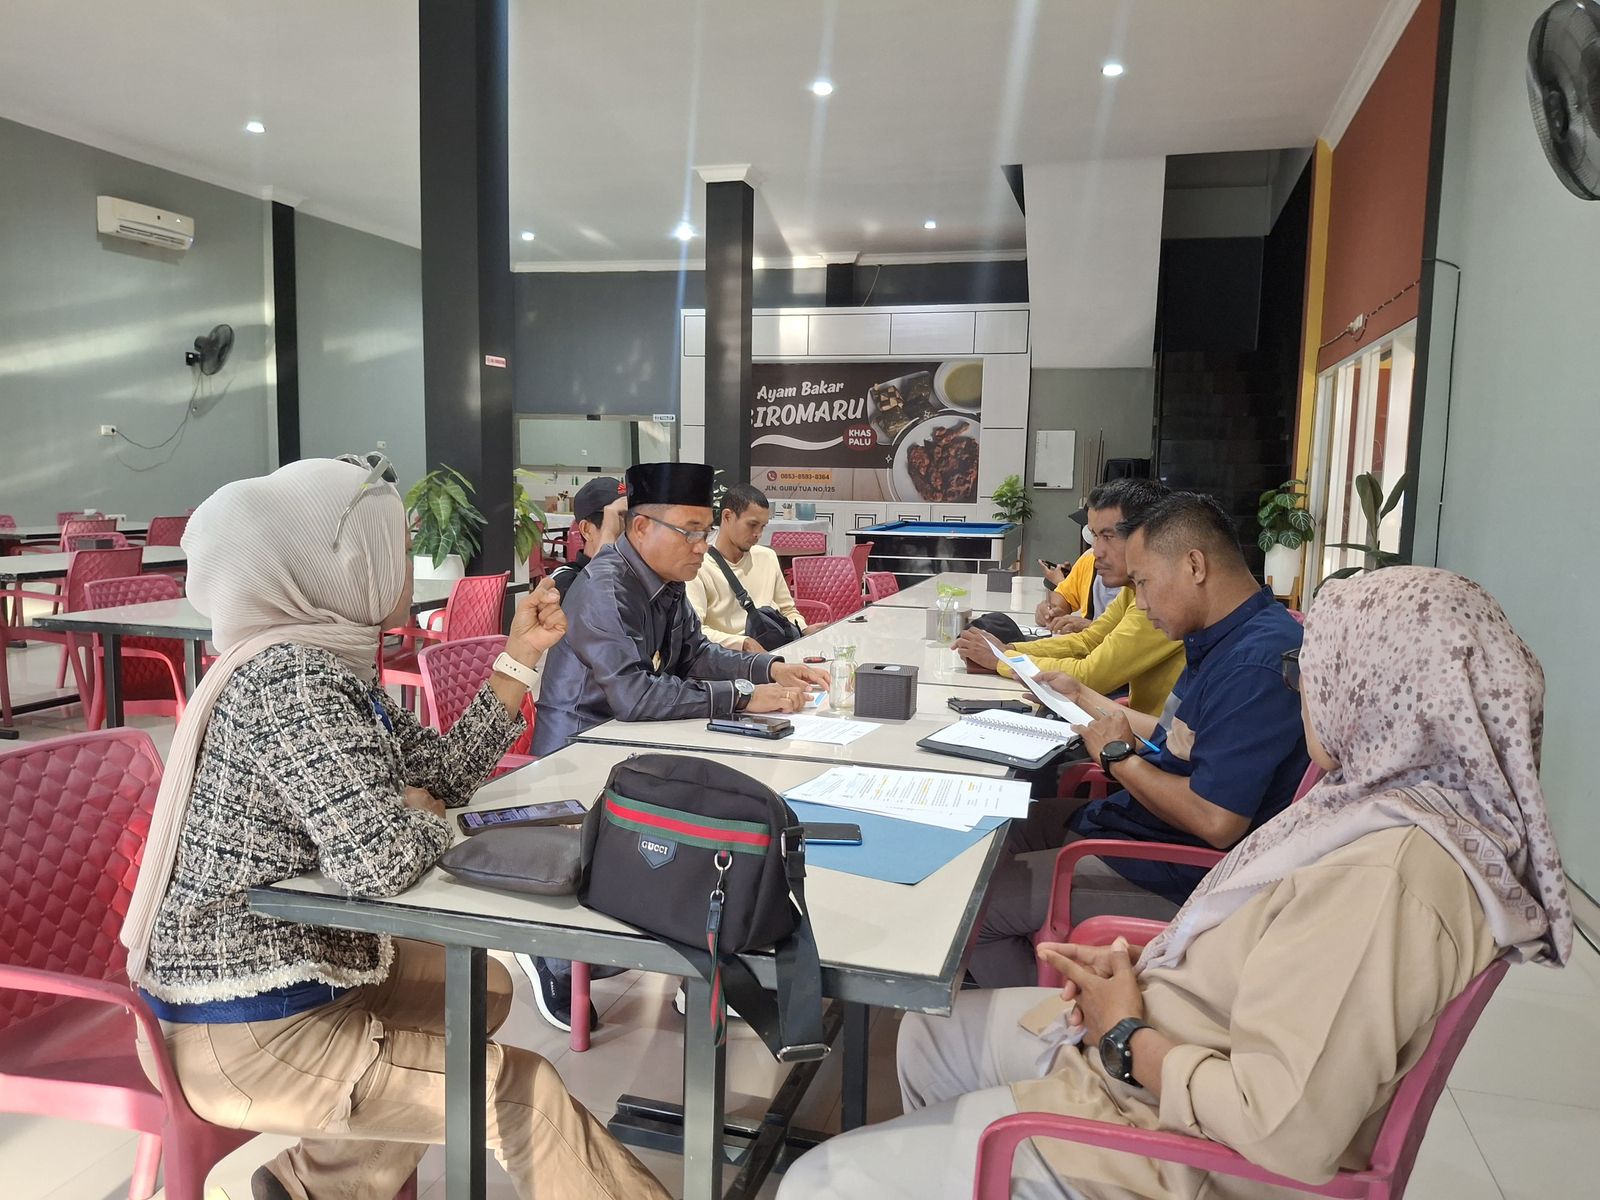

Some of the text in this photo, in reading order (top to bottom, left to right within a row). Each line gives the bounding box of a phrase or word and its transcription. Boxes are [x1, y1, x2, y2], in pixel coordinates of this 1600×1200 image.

[757, 380, 844, 403] Ayam Bakar
[751, 398, 865, 428] IROMARU
[848, 429, 871, 437] KHAS
[848, 438, 871, 446] PALU
[641, 840, 668, 855] GUCCI
